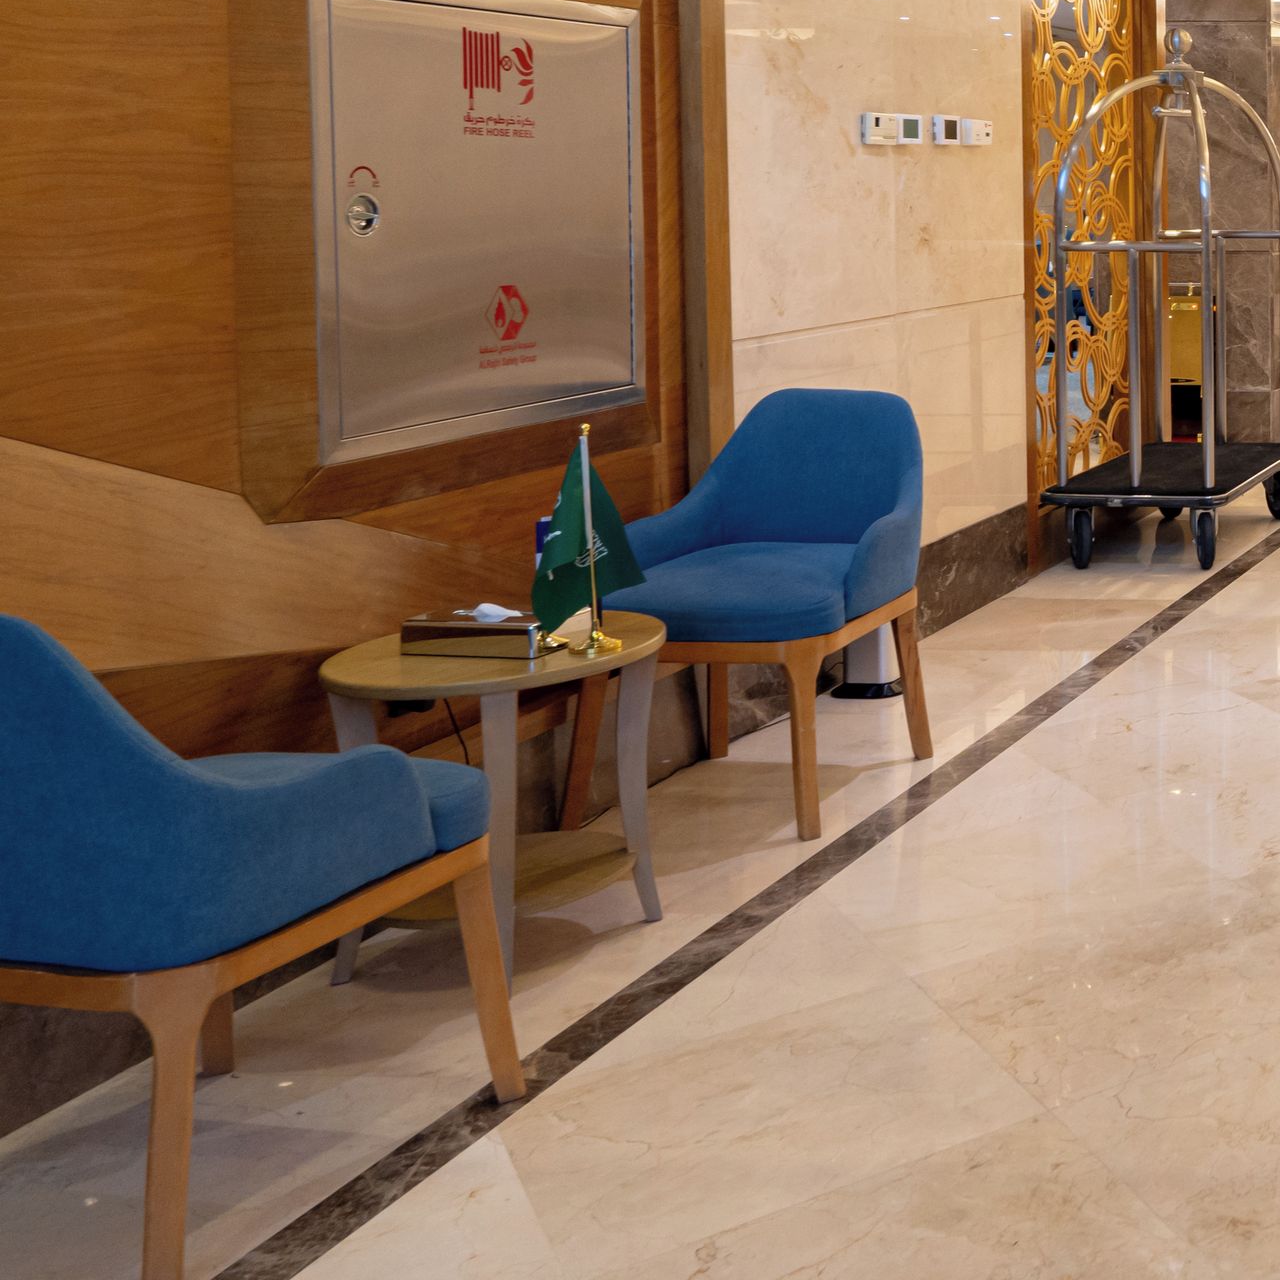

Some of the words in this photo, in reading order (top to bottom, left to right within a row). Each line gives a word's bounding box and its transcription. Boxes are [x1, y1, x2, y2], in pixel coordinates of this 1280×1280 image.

[463, 126, 484, 136] FIRE
[486, 128, 511, 137] HOSE
[512, 129, 536, 139] REEL
